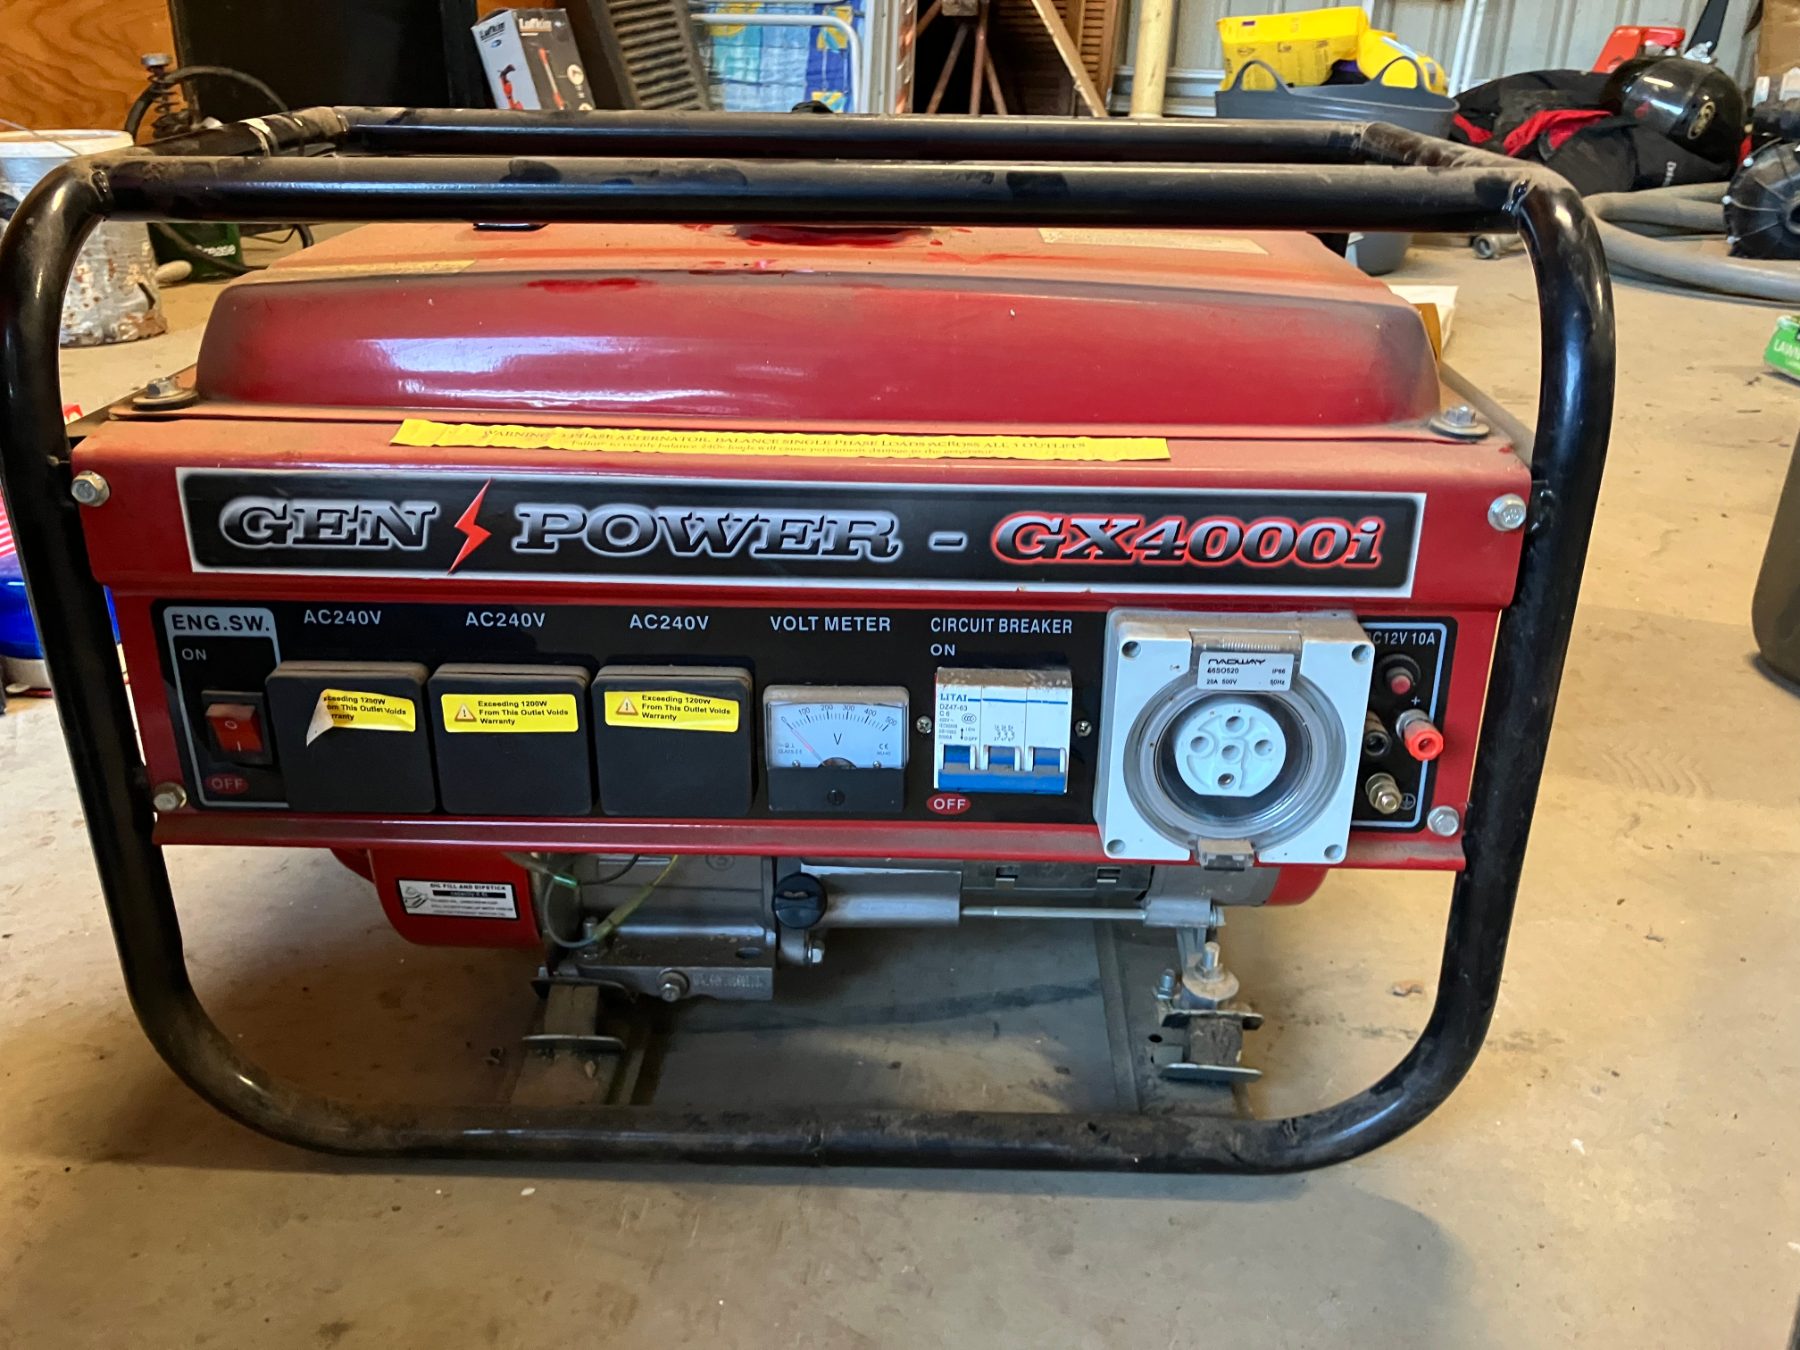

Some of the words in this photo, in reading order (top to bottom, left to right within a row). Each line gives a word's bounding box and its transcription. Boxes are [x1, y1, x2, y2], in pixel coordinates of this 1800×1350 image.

[196, 244, 236, 257] rease
[219, 496, 440, 551] GEN
[512, 503, 902, 562] POWER
[991, 511, 1385, 571] GX4000i
[171, 614, 270, 632] ENG.SW.
[303, 609, 382, 626] AC240V
[465, 611, 546, 628] AC240V
[629, 614, 710, 630] AC240V
[770, 616, 819, 632] VOLT
[824, 616, 891, 632] METER
[930, 617, 995, 633] CIRCUIT
[998, 618, 1072, 634] BREAKER
[1412, 631, 1436, 645] 10A
[181, 648, 207, 661] ON
[929, 643, 956, 657] ON
[642, 694, 683, 704] Exceeding
[685, 696, 711, 705] 1200W
[940, 693, 967, 701] LITAI
[341, 704, 358, 712] This
[360, 705, 383, 713] Outlet
[384, 707, 407, 715] Voids
[478, 700, 519, 708] Exceeding
[642, 703, 663, 711] From
[665, 704, 682, 712] This
[683, 705, 707, 714] Outlet
[709, 706, 731, 715] Voids
[642, 712, 677, 721] Warranty
[798, 707, 811, 715] 100
[864, 709, 877, 717] 400
[833, 733, 843, 745] V
[211, 777, 242, 789] OFF
[933, 798, 966, 810] OFF
